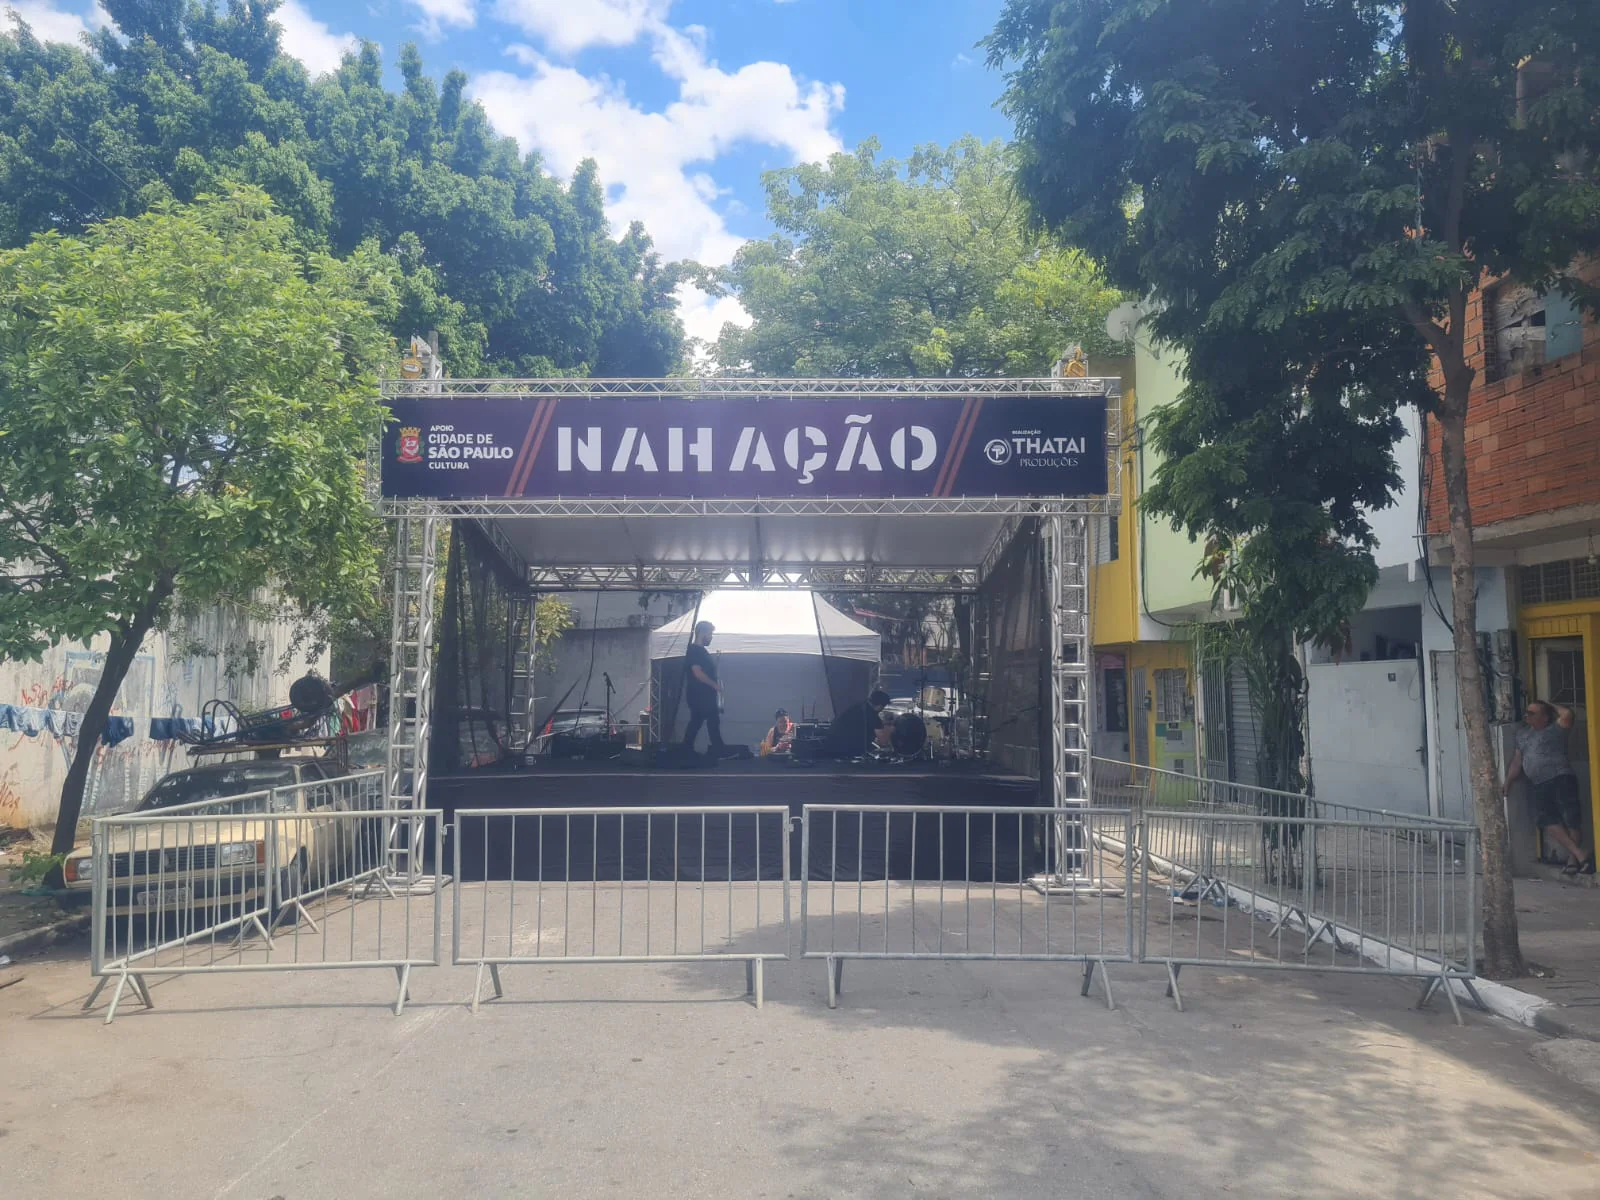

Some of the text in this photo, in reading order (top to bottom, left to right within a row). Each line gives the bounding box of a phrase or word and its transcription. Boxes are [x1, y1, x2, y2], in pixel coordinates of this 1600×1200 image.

[428, 434, 493, 444] CIDADE DE
[1012, 437, 1086, 454] THATAI
[428, 444, 514, 459] SÃO PAULO
[557, 413, 938, 484] NAHAÇÃO
[428, 462, 469, 470] CULTURA
[1020, 457, 1079, 468] PRODUÇÕES
